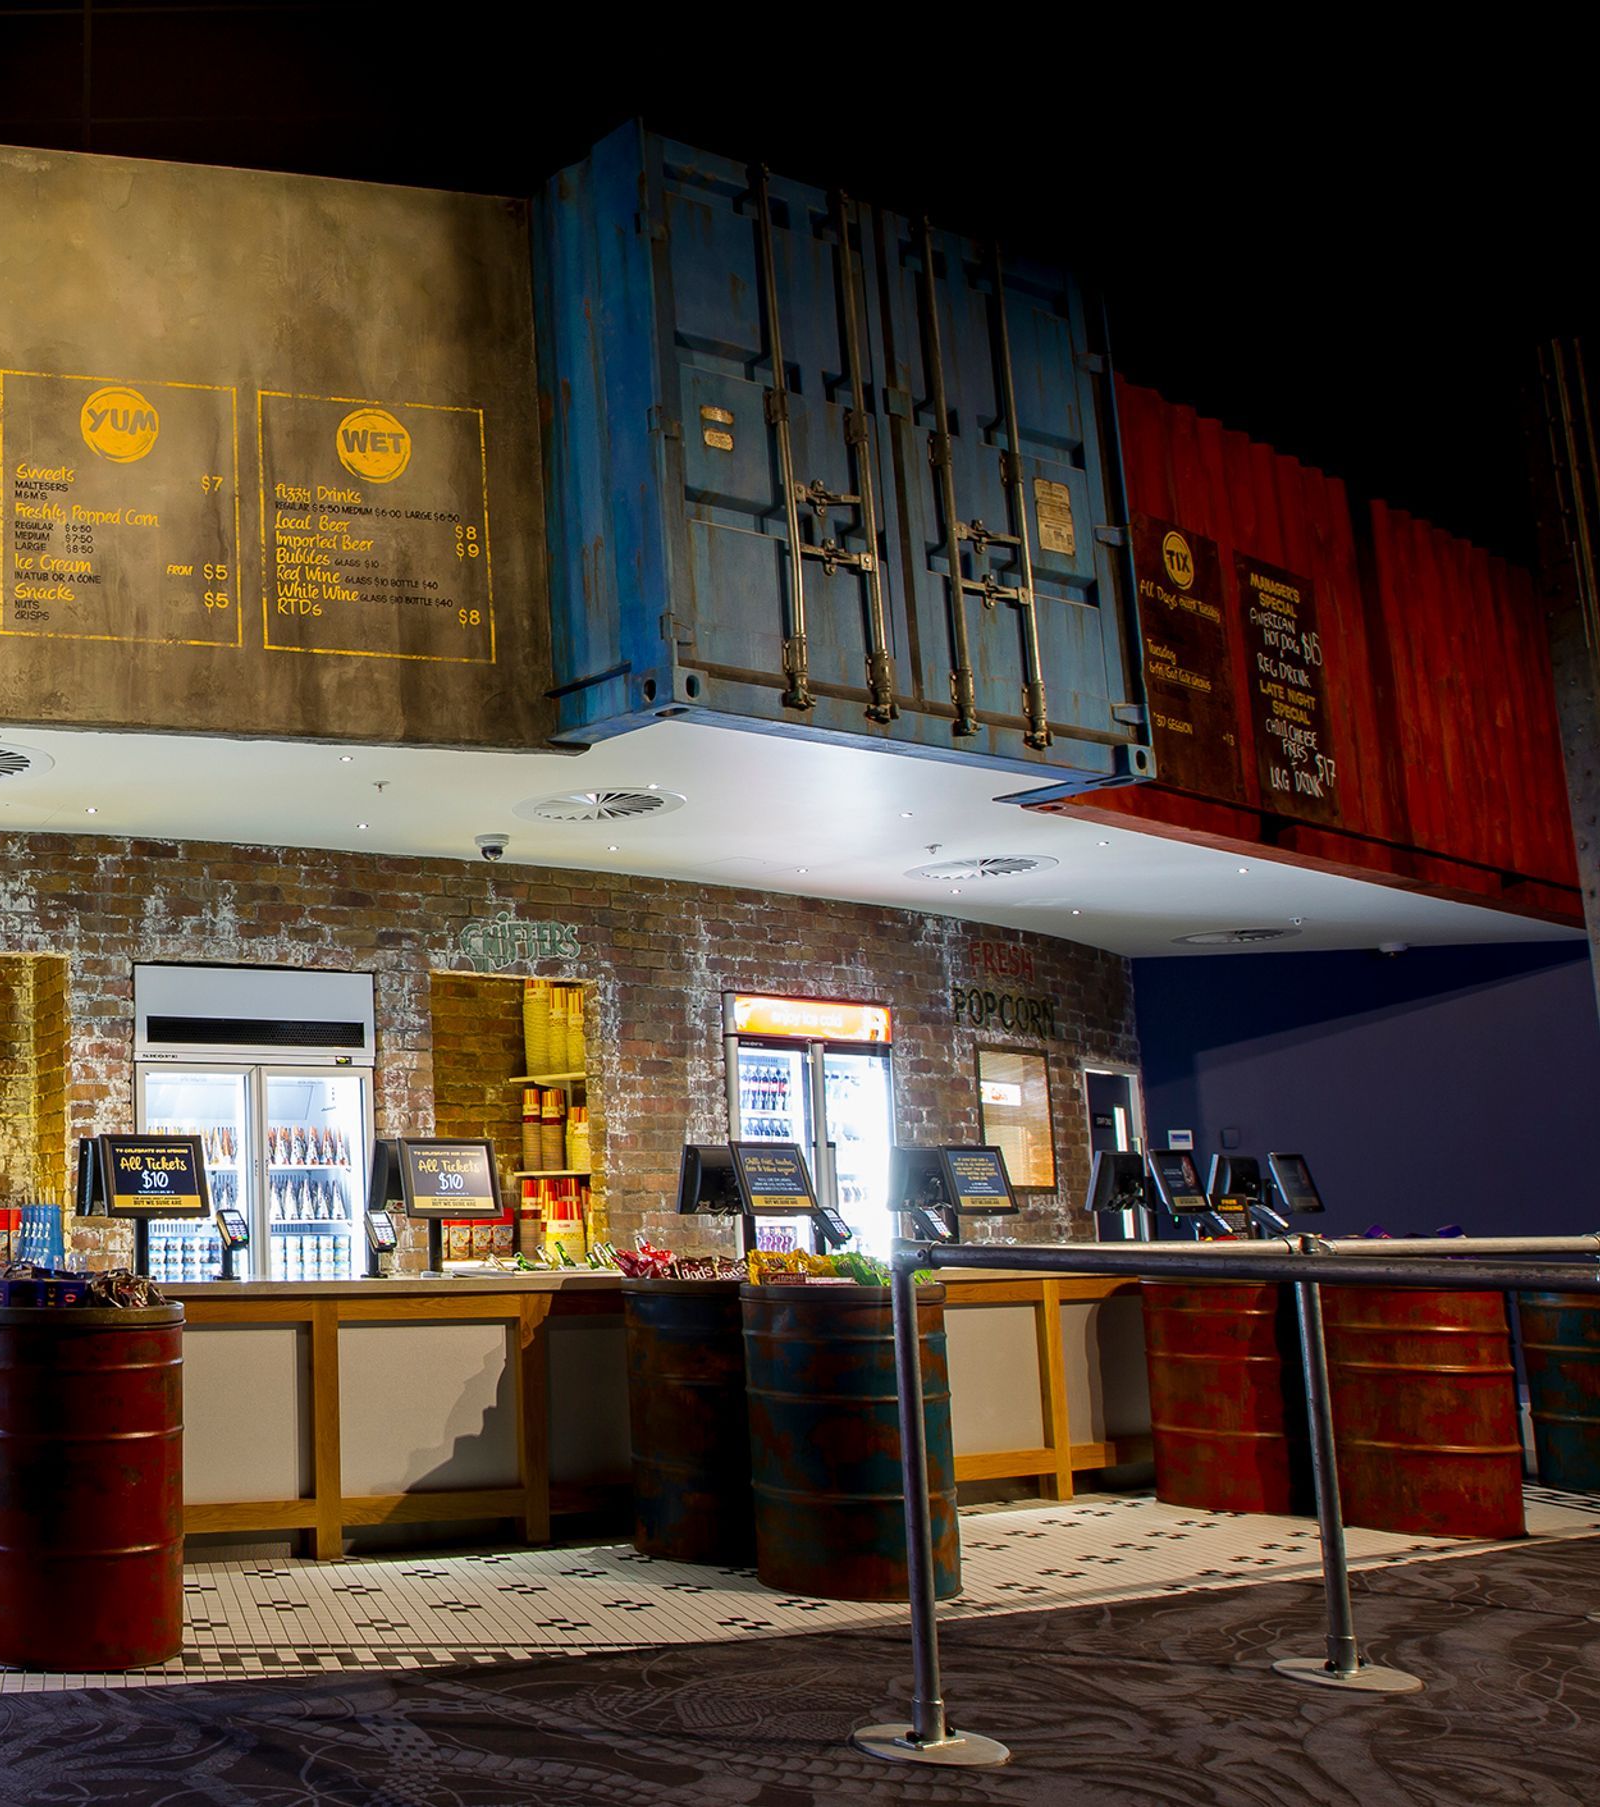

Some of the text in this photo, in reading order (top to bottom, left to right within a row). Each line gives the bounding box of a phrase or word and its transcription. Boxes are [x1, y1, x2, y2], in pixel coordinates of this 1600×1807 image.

[87, 408, 156, 435] YUM
[341, 429, 406, 454] WET
[15, 463, 223, 494] Sweets $7
[15, 481, 69, 492] MALTESERS
[317, 485, 362, 504] Drinks
[15, 502, 160, 528] Freshly Popped Corn
[274, 501, 310, 512] REGULAR
[341, 505, 373, 516] MEDIUM
[405, 510, 432, 520] LARGE
[14, 521, 54, 531] REGULAR
[14, 531, 50, 541] MEDIUM
[274, 510, 478, 541] Local Beer $8
[15, 541, 47, 551] LARGE
[275, 529, 479, 562] Imported Beer $9
[275, 547, 380, 569] Bubbles GLASS $10
[14, 552, 228, 585] Ice Cream FROM $5
[1166, 549, 1191, 574] TIX
[51, 573, 65, 582] OR
[67, 574, 75, 582] A
[77, 573, 101, 584] CONE
[276, 565, 301, 581] Red
[304, 565, 341, 584] Wine
[344, 575, 373, 586] GLASS
[373, 577, 389, 588] $10
[390, 578, 419, 588] BOTTLE
[1250, 571, 1300, 604] MANAGER'S
[14, 582, 229, 614] Snacks $5
[14, 600, 40, 610] NUTS
[277, 581, 319, 600] White
[322, 584, 359, 601] Wine
[360, 593, 388, 604] GLASS
[405, 596, 432, 607] BOTTLE
[1139, 579, 1155, 598] All
[1156, 585, 1178, 612] Days
[1259, 591, 1298, 619] SPECIAL
[14, 610, 50, 621] CRISPS
[277, 597, 480, 629] RTDs $8
[1249, 607, 1296, 634] AMERICAN
[1263, 627, 1323, 667] HOT DOG $15
[1257, 652, 1311, 688] REG DRINK
[1259, 680, 1316, 711] LATE NIGHT
[1272, 701, 1311, 725] SPECIAL
[1288, 724, 1318, 751] CHEESE
[1282, 738, 1337, 788] FRIES $17
[1270, 766, 1325, 799] LRG DRINK
[968, 941, 1035, 984] FRESH
[952, 986, 1056, 1042] POPCORN
[120, 1156, 187, 1171] All Tickets
[418, 1158, 481, 1174] All Tickets
[141, 1169, 169, 1189] $10
[438, 1171, 463, 1190] $10
